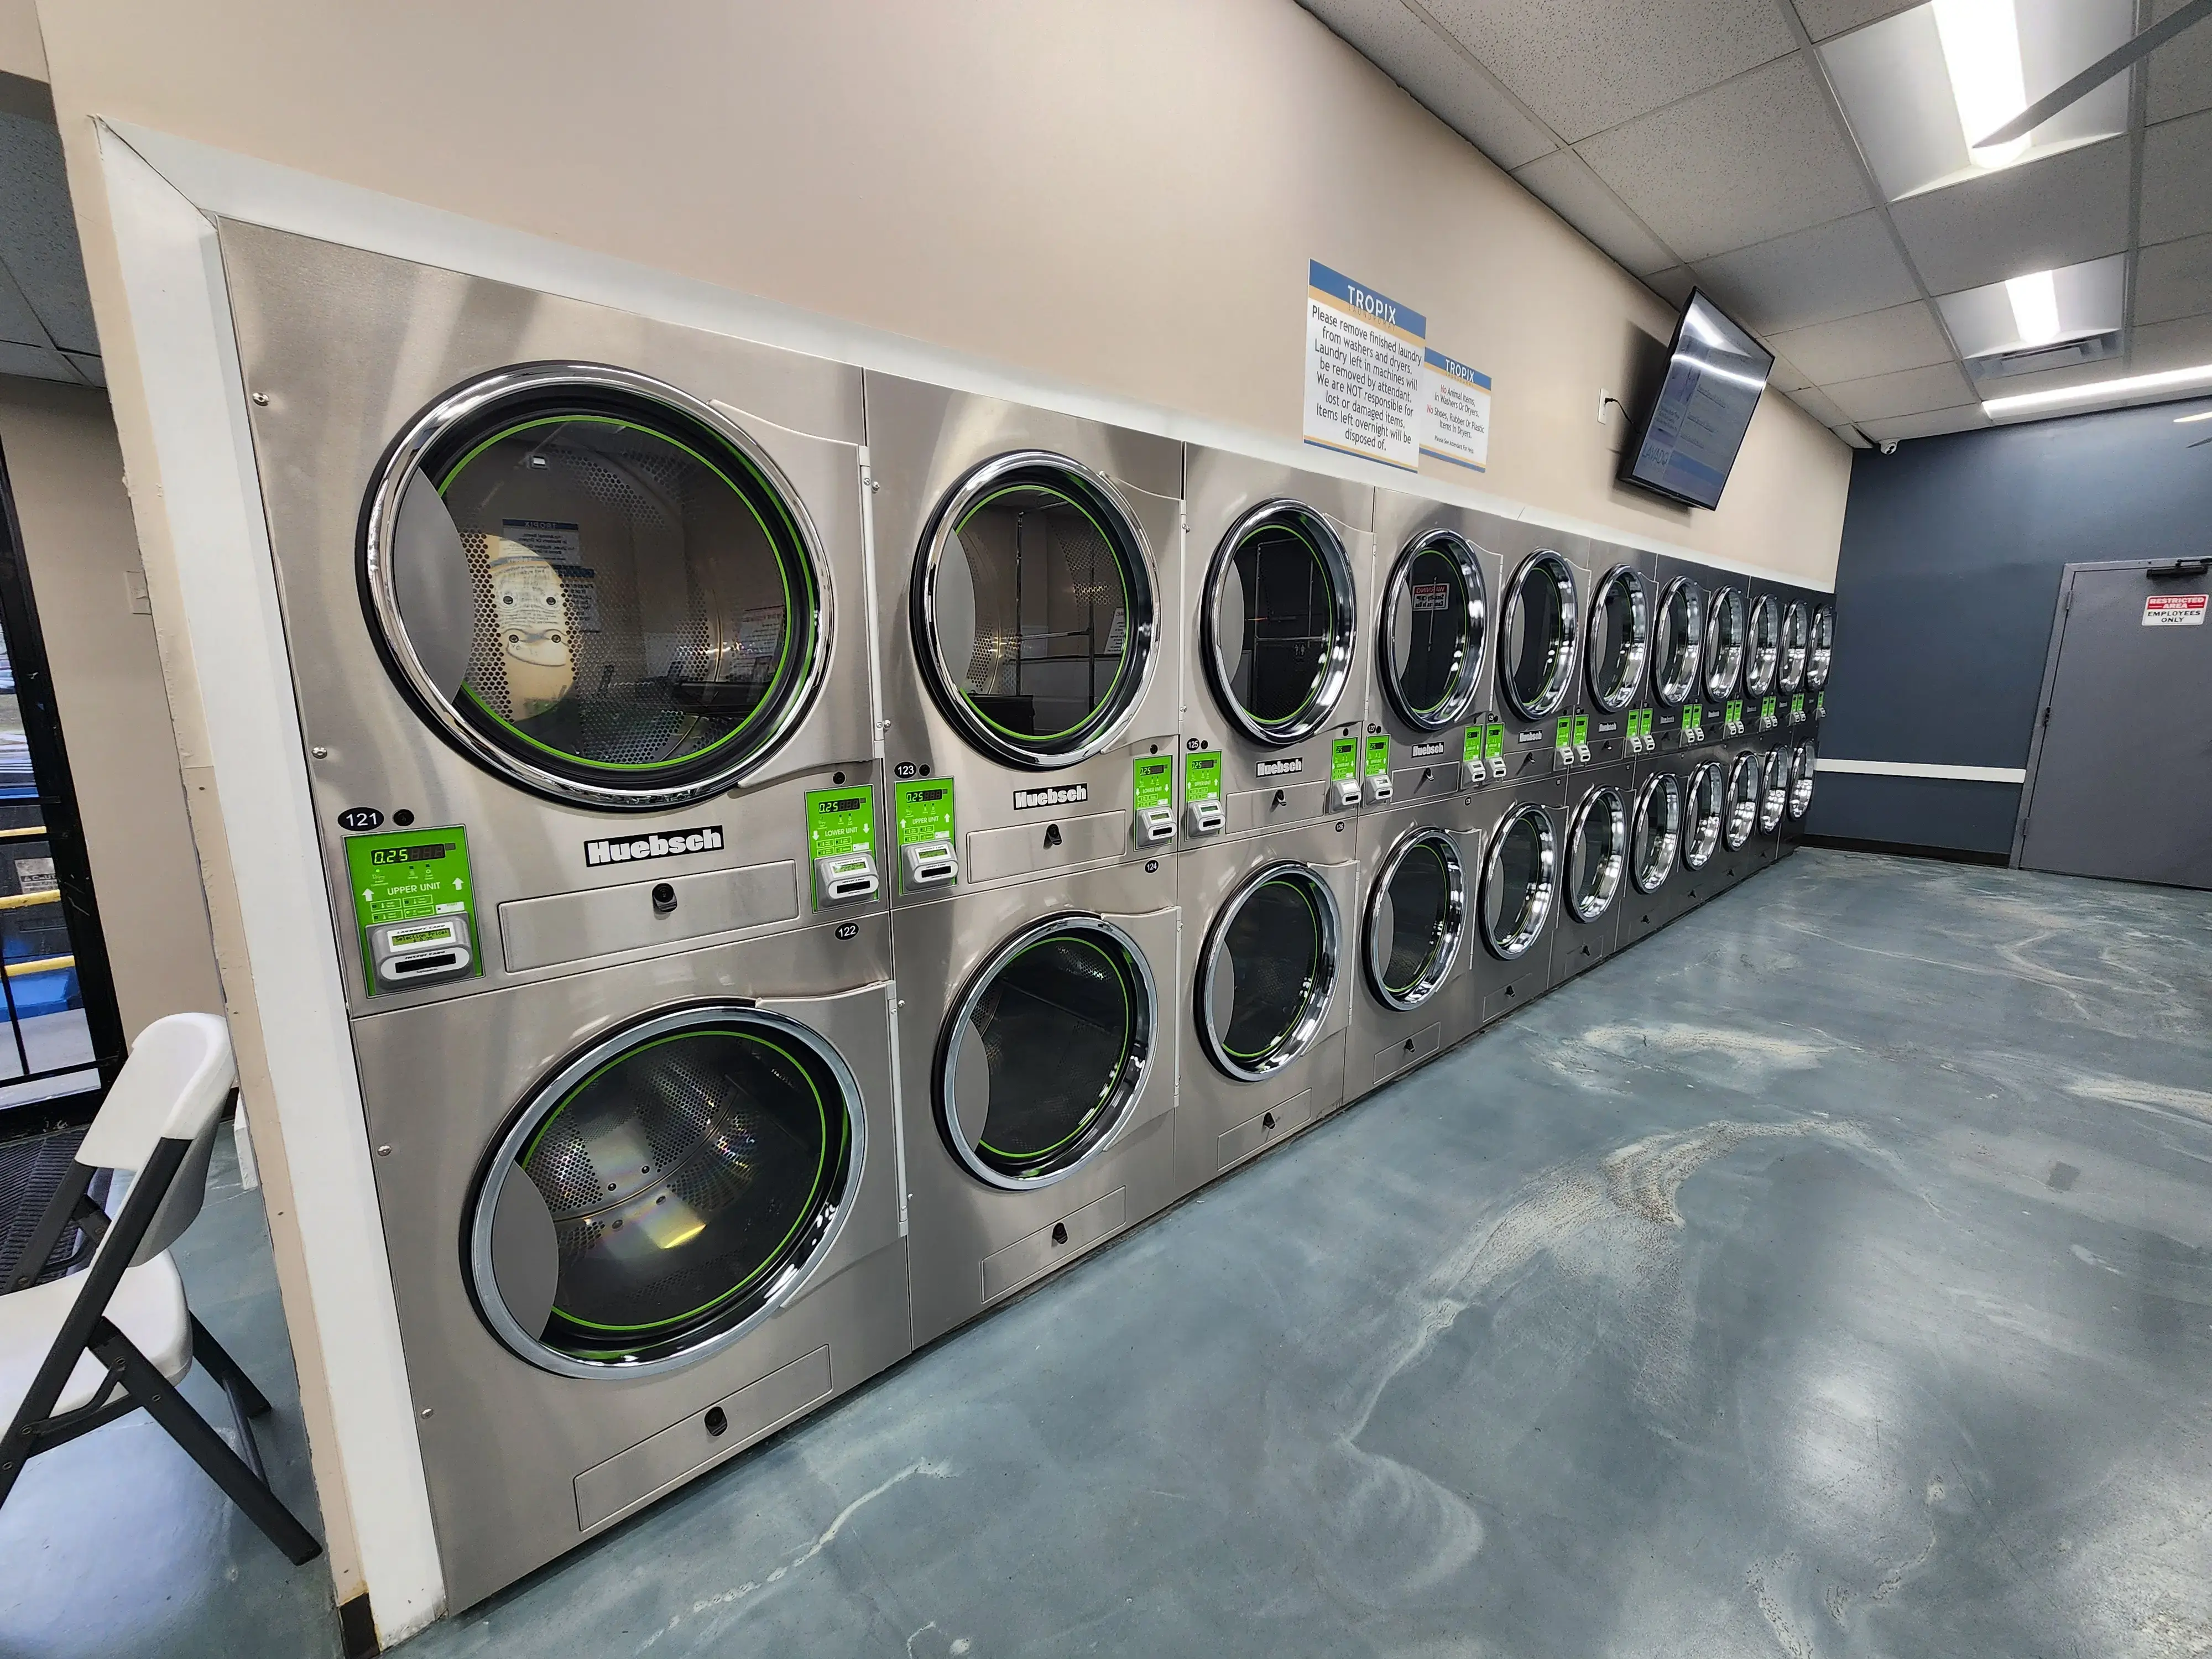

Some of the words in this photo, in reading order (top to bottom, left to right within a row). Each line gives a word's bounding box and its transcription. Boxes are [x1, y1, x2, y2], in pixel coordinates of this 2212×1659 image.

[1348, 285, 1396, 325] TROPIX
[1312, 305, 1338, 327] Please
[1340, 319, 1368, 340] remove
[1369, 331, 1396, 353] finished
[1398, 343, 1422, 366] laundry
[1322, 326, 1341, 345] from
[1343, 337, 1373, 358] washers
[1375, 351, 1387, 364] and
[1390, 355, 1412, 375] dryers.
[1315, 338, 1347, 365] Laundry
[1349, 352, 1362, 369] left
[1364, 358, 1371, 372] in
[1373, 367, 1405, 387] machines
[1406, 378, 1417, 391] will
[1446, 359, 1475, 383] TROPIX
[1320, 357, 1330, 372] be
[1332, 364, 1365, 385] removed
[1368, 375, 1376, 391] by
[1378, 382, 1412, 403] attendant.
[1317, 371, 1329, 387] We
[1332, 380, 1344, 393] are
[1347, 383, 1363, 399] NOT
[1364, 391, 1402, 414] responsible
[1404, 404, 1413, 418] for
[1434, 392, 1439, 401] In
[1440, 394, 1458, 409] Washers
[1459, 402, 1464, 411] Or
[1465, 404, 1479, 418] Dryers.
[1441, 384, 1447, 394] No
[1447, 388, 1462, 400] Animal
[1463, 393, 1475, 407] Items,
[1326, 390, 1339, 406] lost
[1342, 399, 1350, 409] or
[1352, 400, 1383, 421] damaged
[1385, 411, 1405, 429] items.
[1427, 404, 1433, 414] No
[1434, 407, 1449, 421] Shoes,
[1449, 413, 1465, 426] Rubber
[1465, 419, 1471, 428] Or
[1472, 421, 1485, 434] Plastic
[1317, 403, 1338, 421] Items
[1340, 410, 1353, 426] left
[1355, 419, 1388, 437] overnight
[1390, 429, 1402, 442] will
[1403, 431, 1411, 444] be
[1439, 420, 1452, 431] Items
[1452, 424, 1457, 432] In
[1457, 426, 1472, 439] Dryers.
[1345, 427, 1376, 448] disposed
[1378, 440, 1386, 451] of.
[1188, 740, 1199, 749] 125
[1413, 743, 1444, 757] Huebsch
[898, 765, 915, 775] 123
[1257, 759, 1302, 776] Huebsch
[1015, 785, 1087, 809] Huebsch
[346, 812, 378, 827] 121
[825, 828, 845, 837] LOWER
[374, 849, 409, 864] 0.25
[588, 829, 722, 865] Huebsch
[1146, 862, 1157, 872] 124
[387, 885, 418, 895] UPPER
[420, 881, 441, 891] UNIT
[395, 934, 426, 942] Selection
[838, 925, 857, 937] 122
